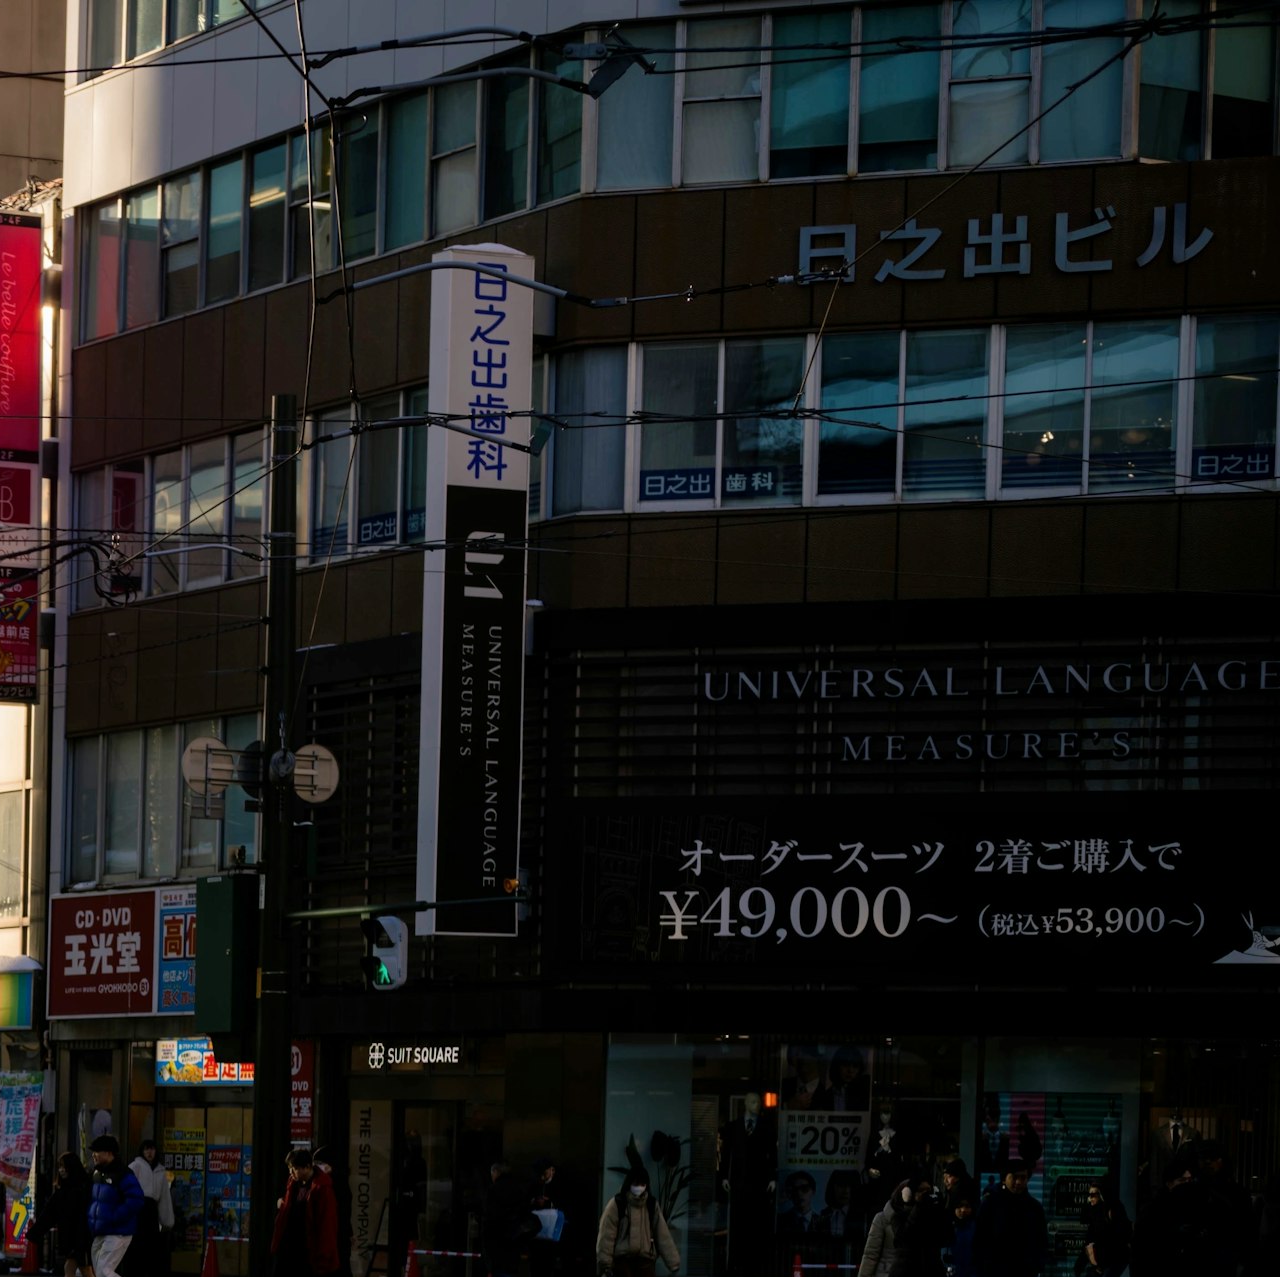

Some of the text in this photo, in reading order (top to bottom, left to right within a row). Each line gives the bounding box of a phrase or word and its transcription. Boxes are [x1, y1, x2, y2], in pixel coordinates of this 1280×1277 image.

[797, 201, 1216, 287] 日之出ビル
[467, 262, 510, 481] 日之出歯科
[1196, 452, 1270, 477] 日之出
[643, 472, 775, 496] 日之出 歯科
[360, 516, 397, 542] 日之出
[459, 622, 476, 757] MEASURE'S
[701, 659, 1280, 702] UNIVERSAL LANGUAGE
[481, 624, 503, 889] UNIVERSAL LANGUAGE
[839, 730, 1134, 762] MEASURE'S
[679, 838, 1184, 876] オーダースーツ 2着ご購入で
[63, 931, 142, 977] 玉光堂
[387, 1045, 460, 1065] SUIT SQUARE
[800, 1125, 861, 1155] 20%
[840, 1146, 860, 1156] OFF
[164, 1153, 204, 1171] 即日修理
[356, 1106, 372, 1261] THE SUIT COMPANY
